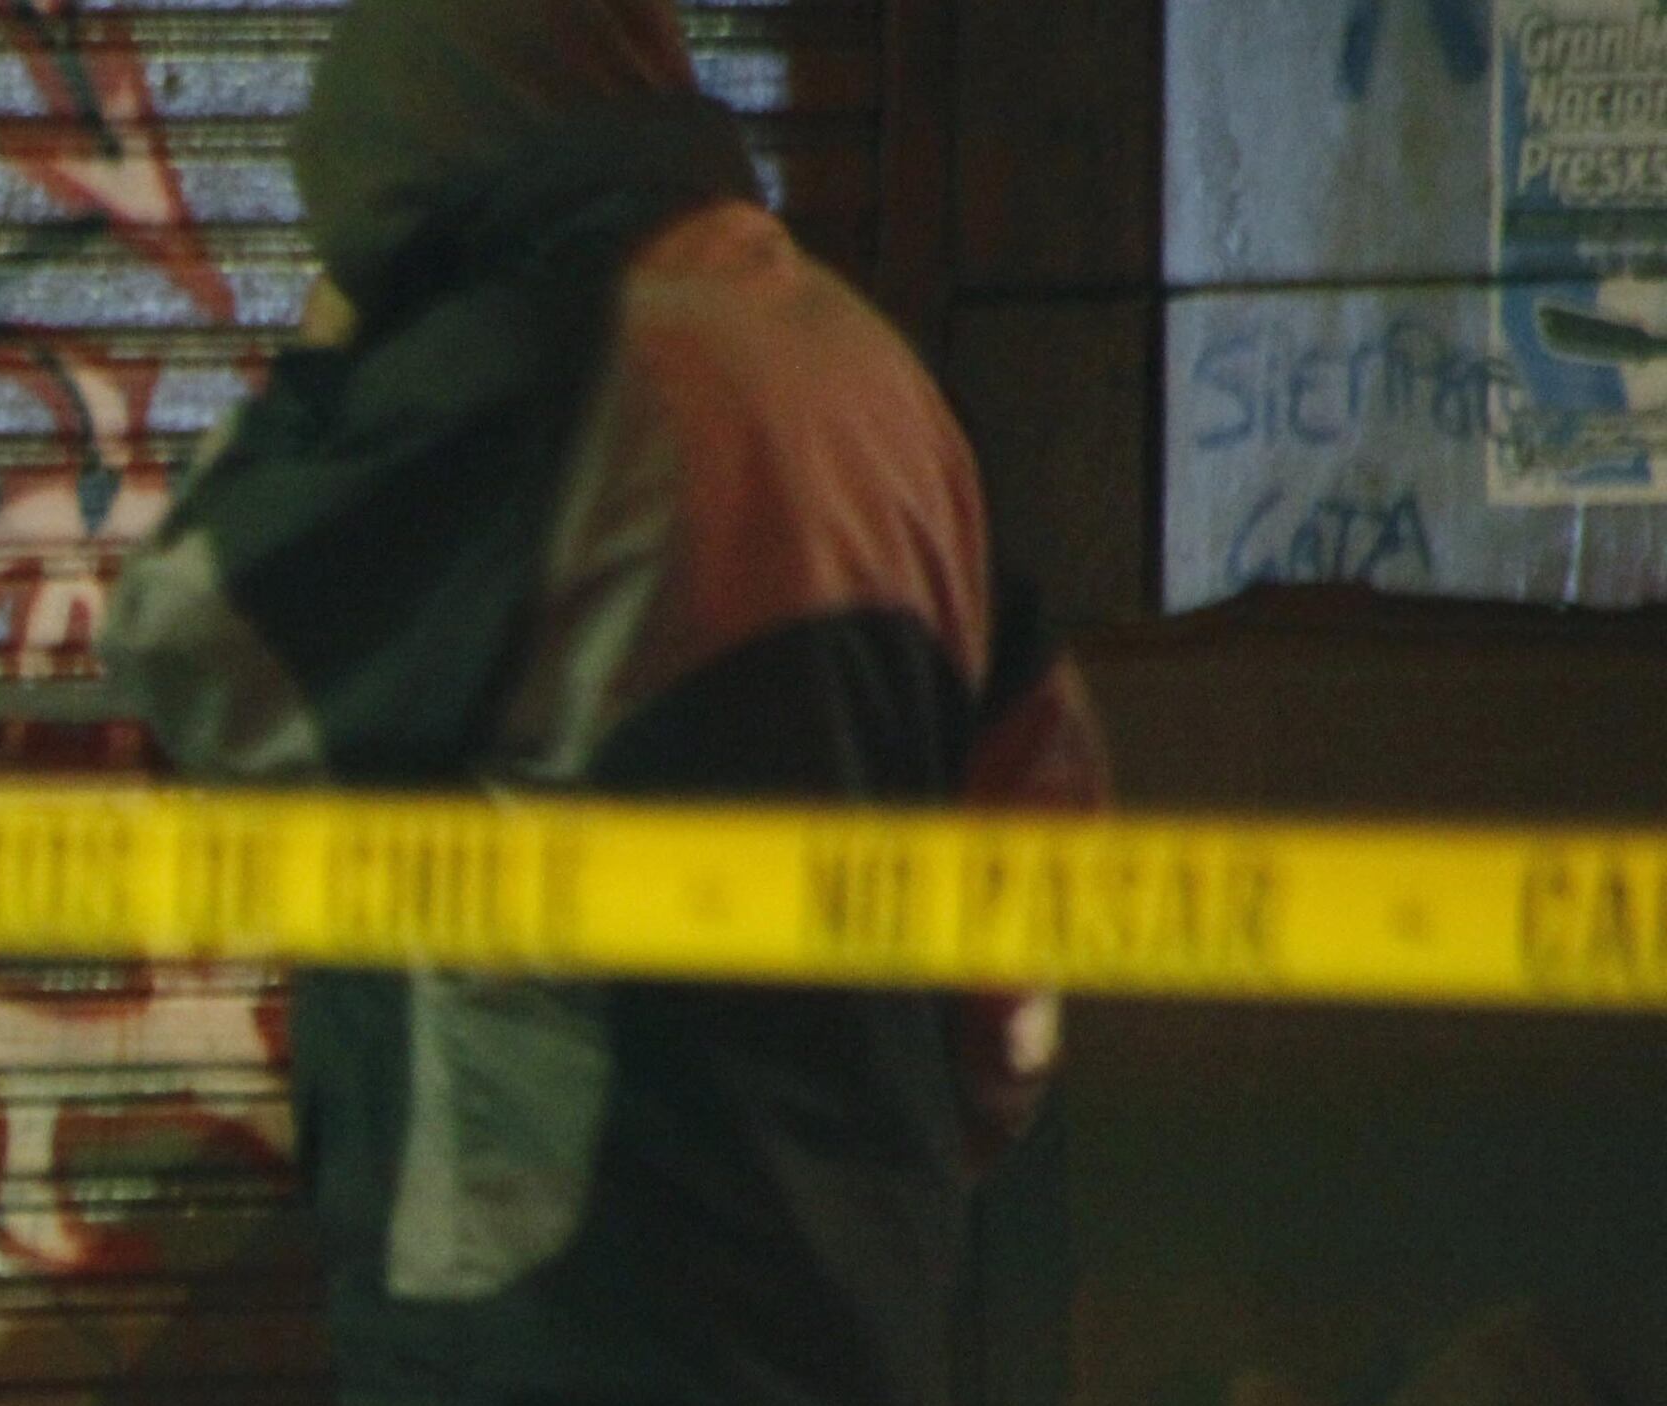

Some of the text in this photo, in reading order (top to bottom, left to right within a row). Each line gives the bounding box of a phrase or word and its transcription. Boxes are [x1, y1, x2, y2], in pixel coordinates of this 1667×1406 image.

[1519, 17, 1625, 70] Gran
[192, 817, 279, 934] DE
[327, 818, 582, 947] CHILE
[799, 835, 929, 958] NO
[959, 835, 1289, 973] PASAR
[1517, 849, 1667, 986] CA
